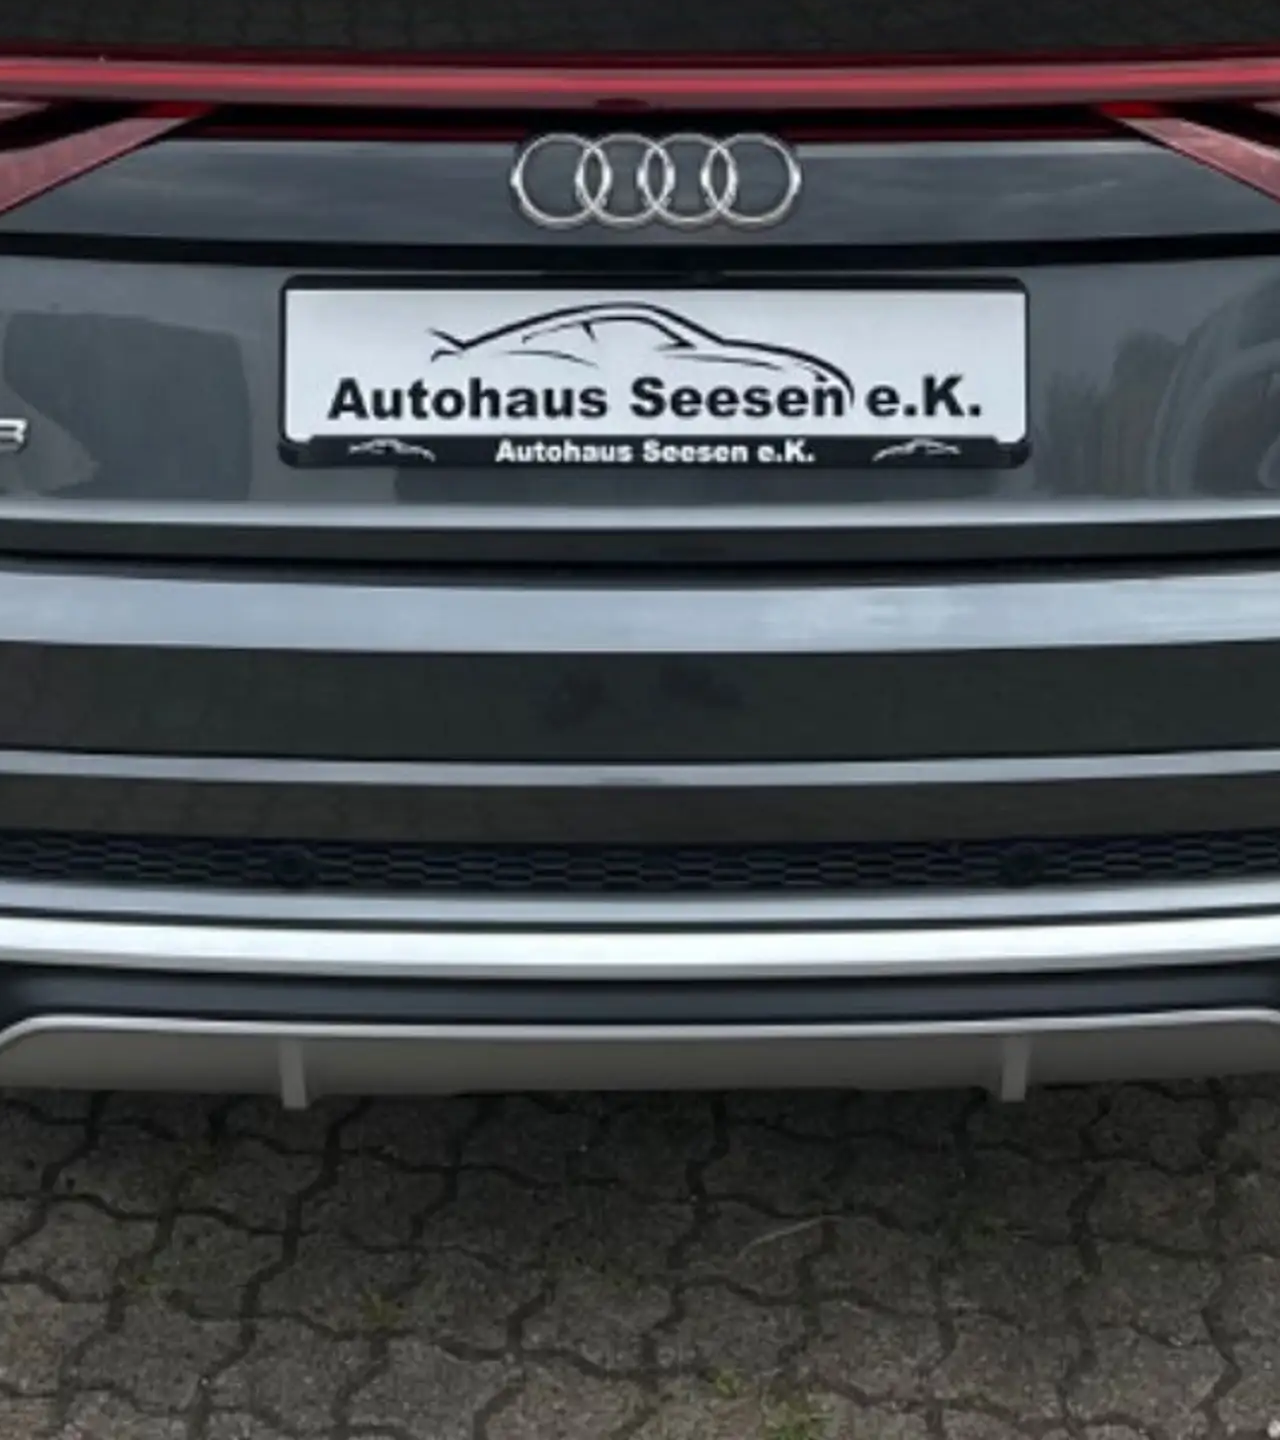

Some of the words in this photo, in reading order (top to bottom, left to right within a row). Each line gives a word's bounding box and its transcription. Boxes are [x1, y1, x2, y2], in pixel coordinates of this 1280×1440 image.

[327, 376, 608, 420] Autohaus
[630, 375, 846, 418] Seesen
[865, 374, 982, 418] e.K.
[495, 439, 633, 462] Autohaus
[642, 439, 749, 462] Seesen
[757, 438, 816, 462] e.K.
